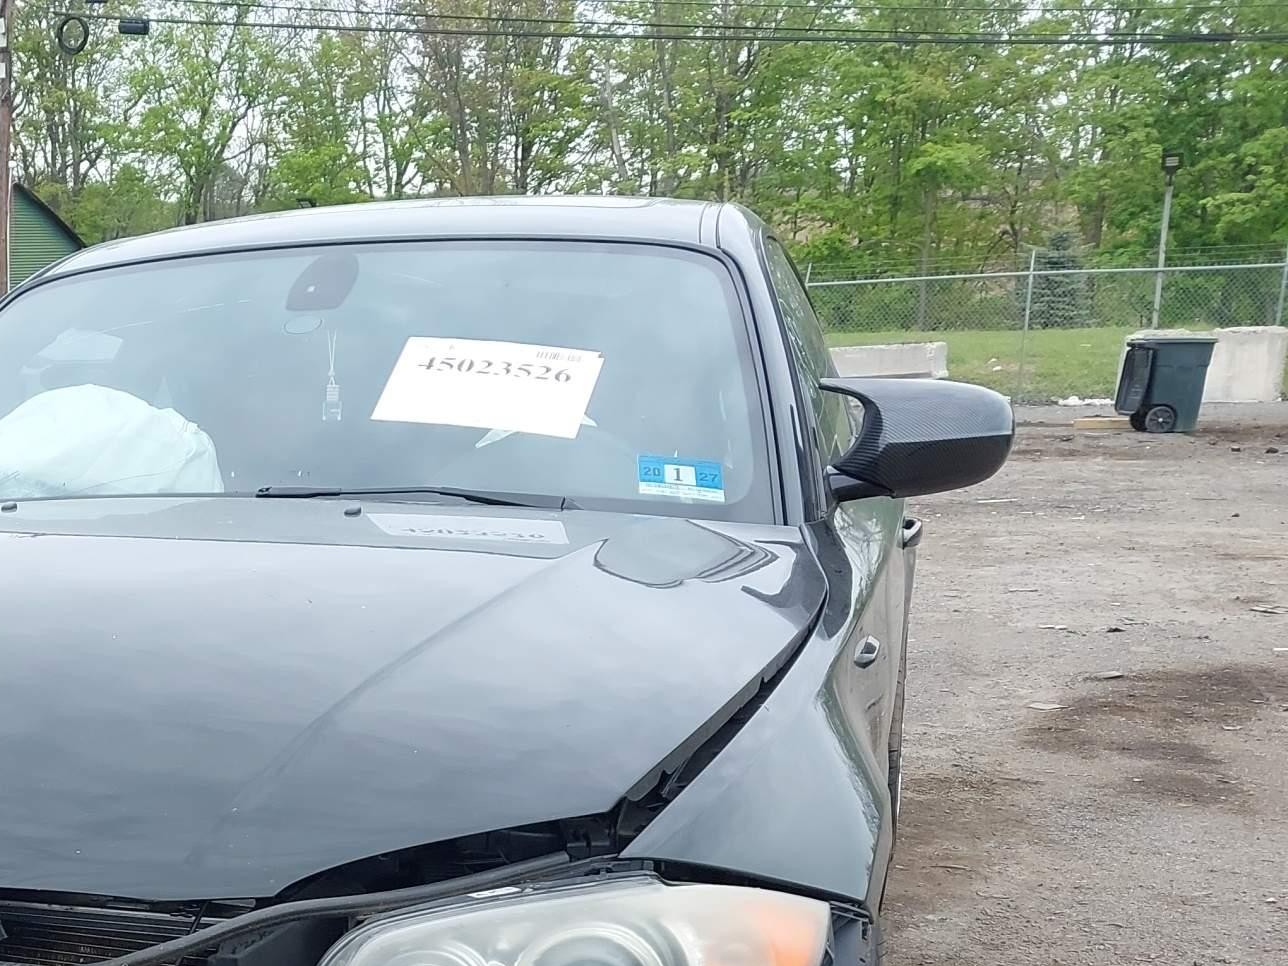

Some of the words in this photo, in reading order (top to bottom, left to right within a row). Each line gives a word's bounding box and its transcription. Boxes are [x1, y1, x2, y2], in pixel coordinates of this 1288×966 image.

[417, 356, 572, 383] 45023526
[642, 466, 661, 477] 20
[673, 467, 683, 482] 1
[699, 472, 720, 483] 27
